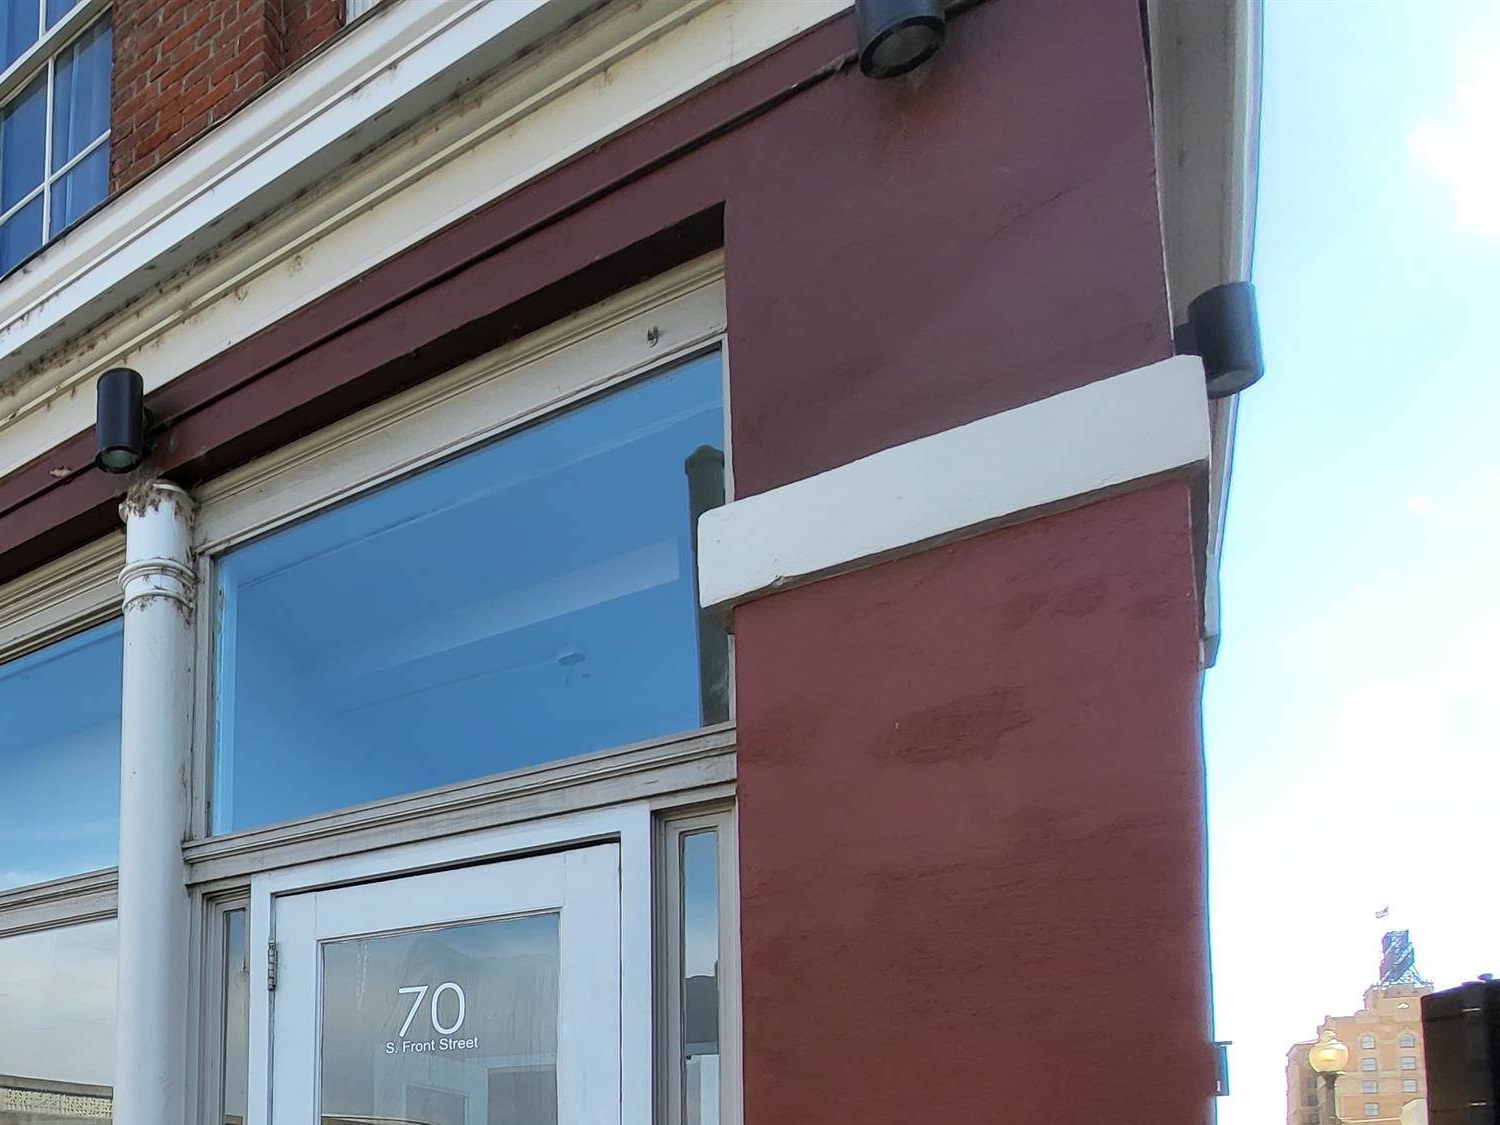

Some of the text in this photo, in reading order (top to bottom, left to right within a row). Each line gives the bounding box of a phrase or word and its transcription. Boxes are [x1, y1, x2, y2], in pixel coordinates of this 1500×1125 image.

[398, 982, 466, 1038] 70
[385, 1036, 479, 1054] S. Front Street
